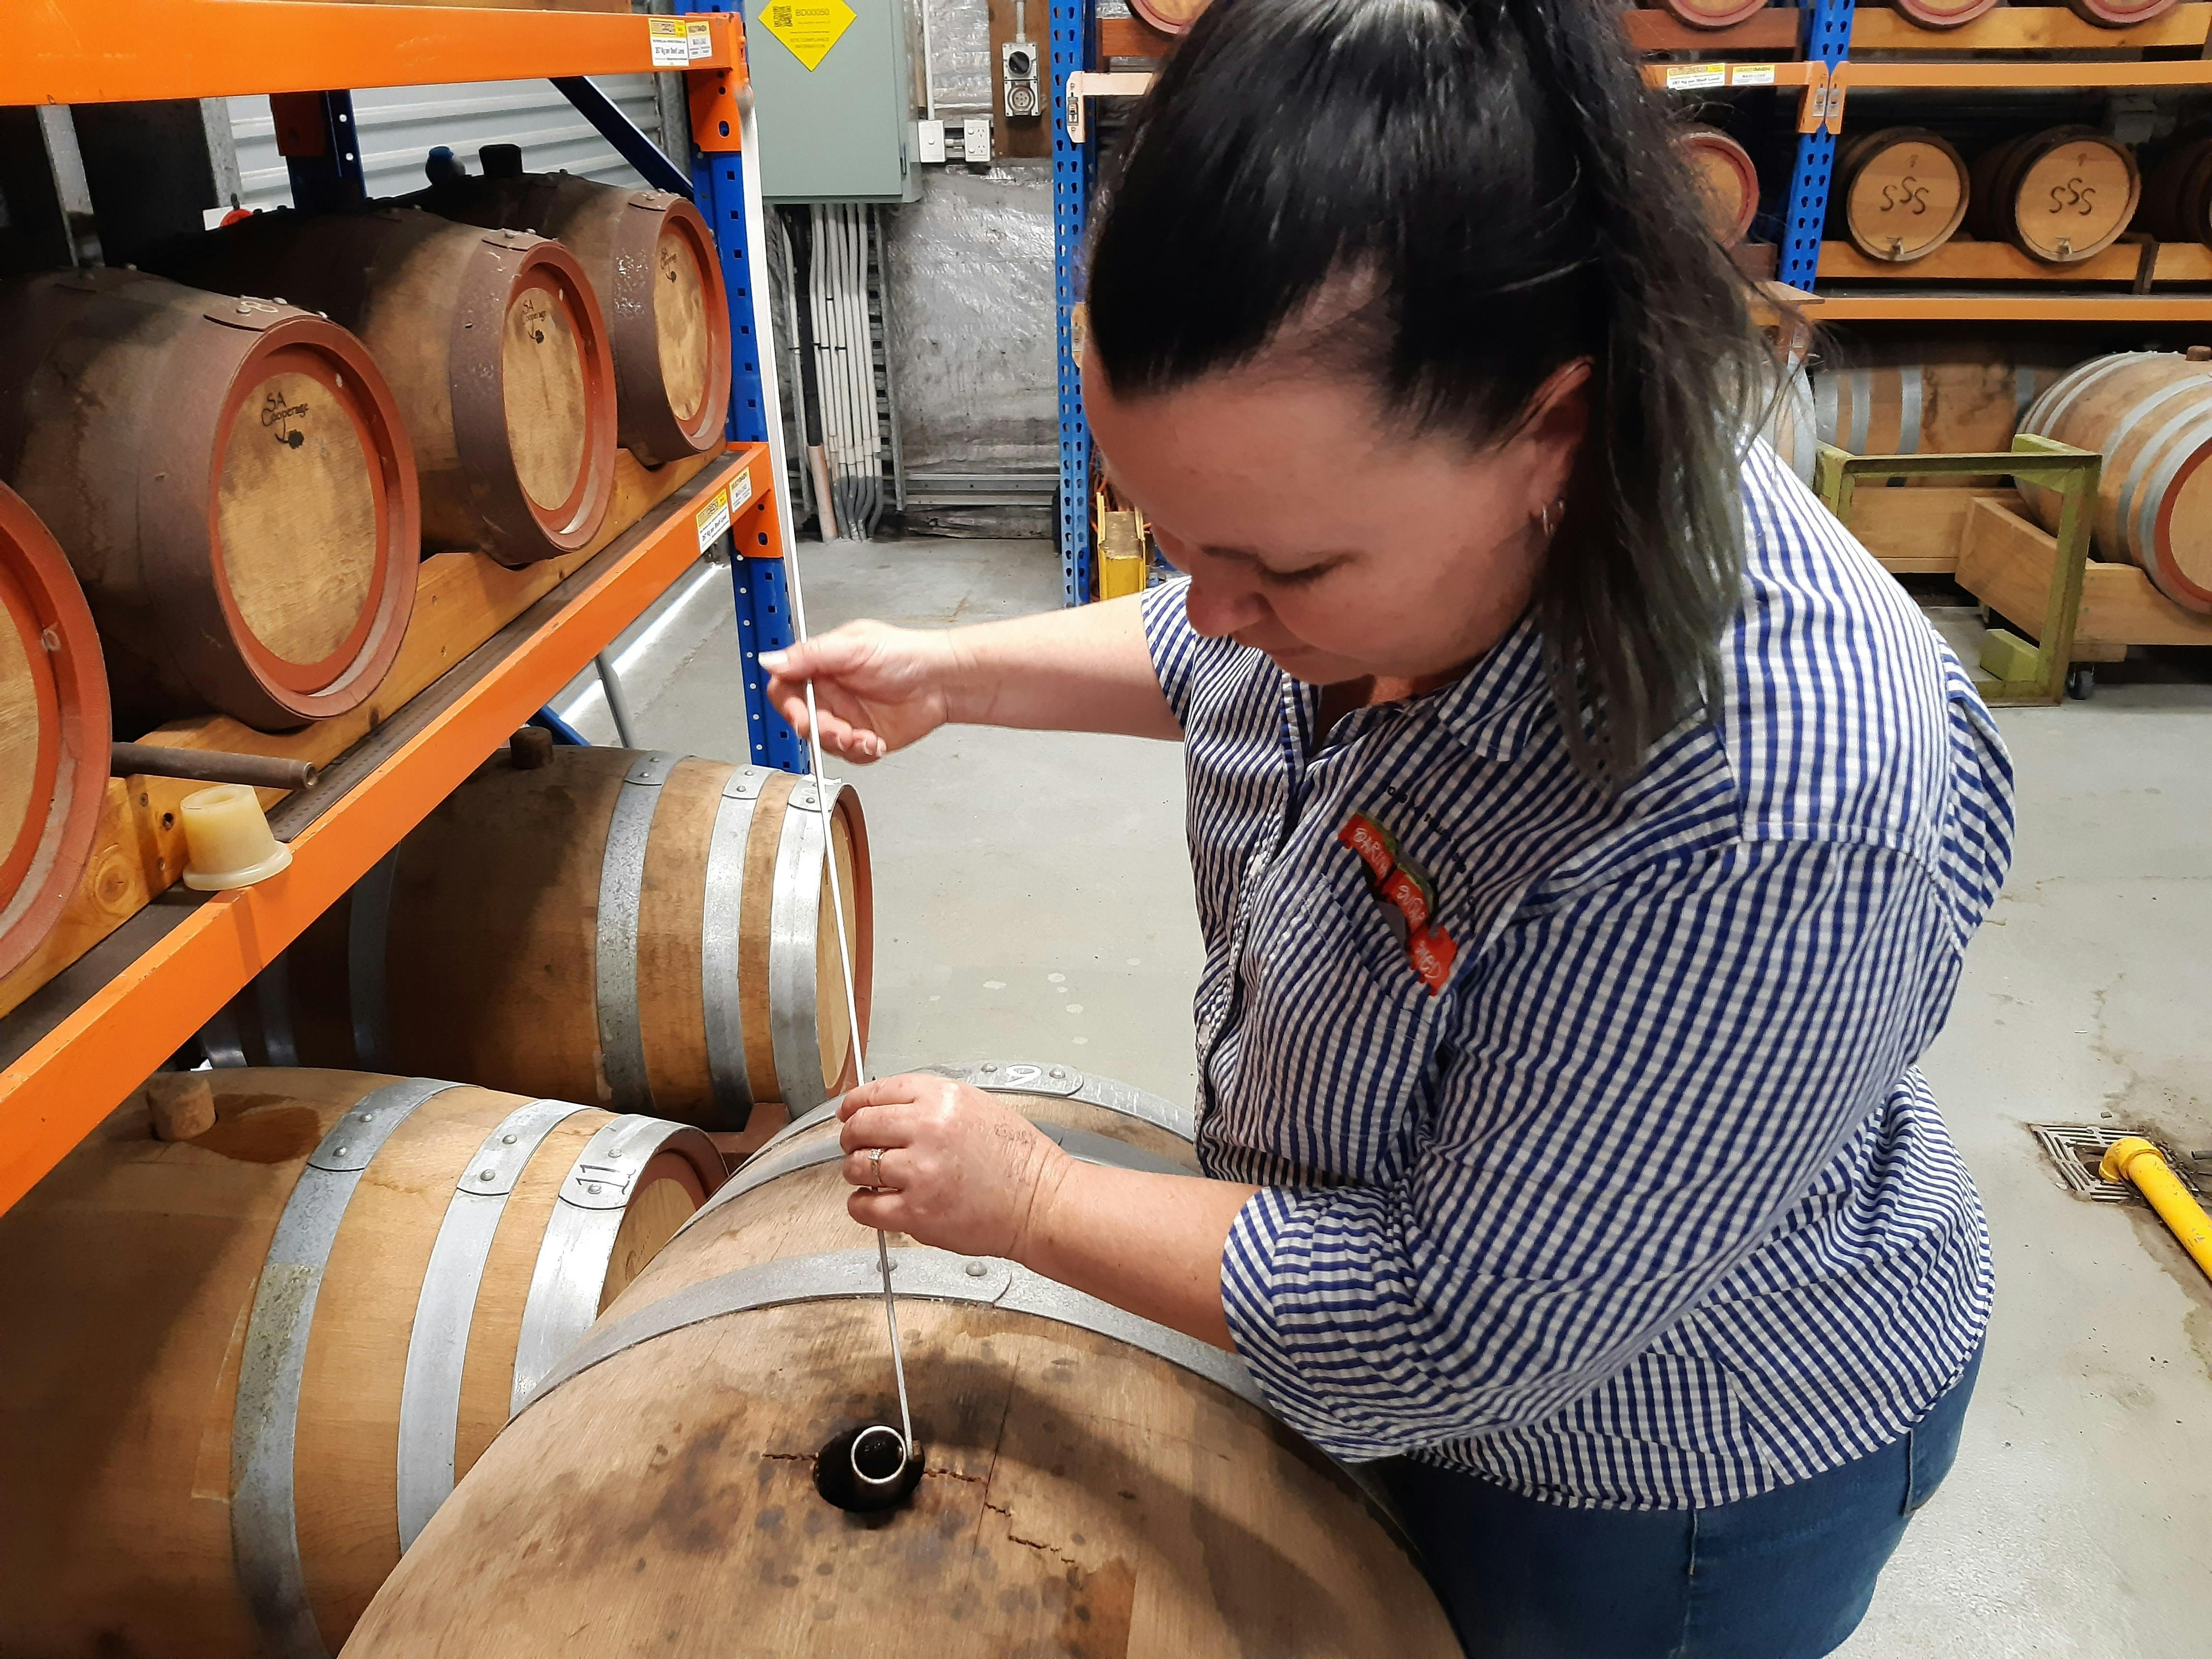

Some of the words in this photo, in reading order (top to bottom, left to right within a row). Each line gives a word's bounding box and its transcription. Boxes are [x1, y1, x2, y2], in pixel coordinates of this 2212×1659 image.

[1880, 176, 1929, 215] SSS
[2049, 177, 2096, 216] SSS
[264, 391, 287, 411] SA
